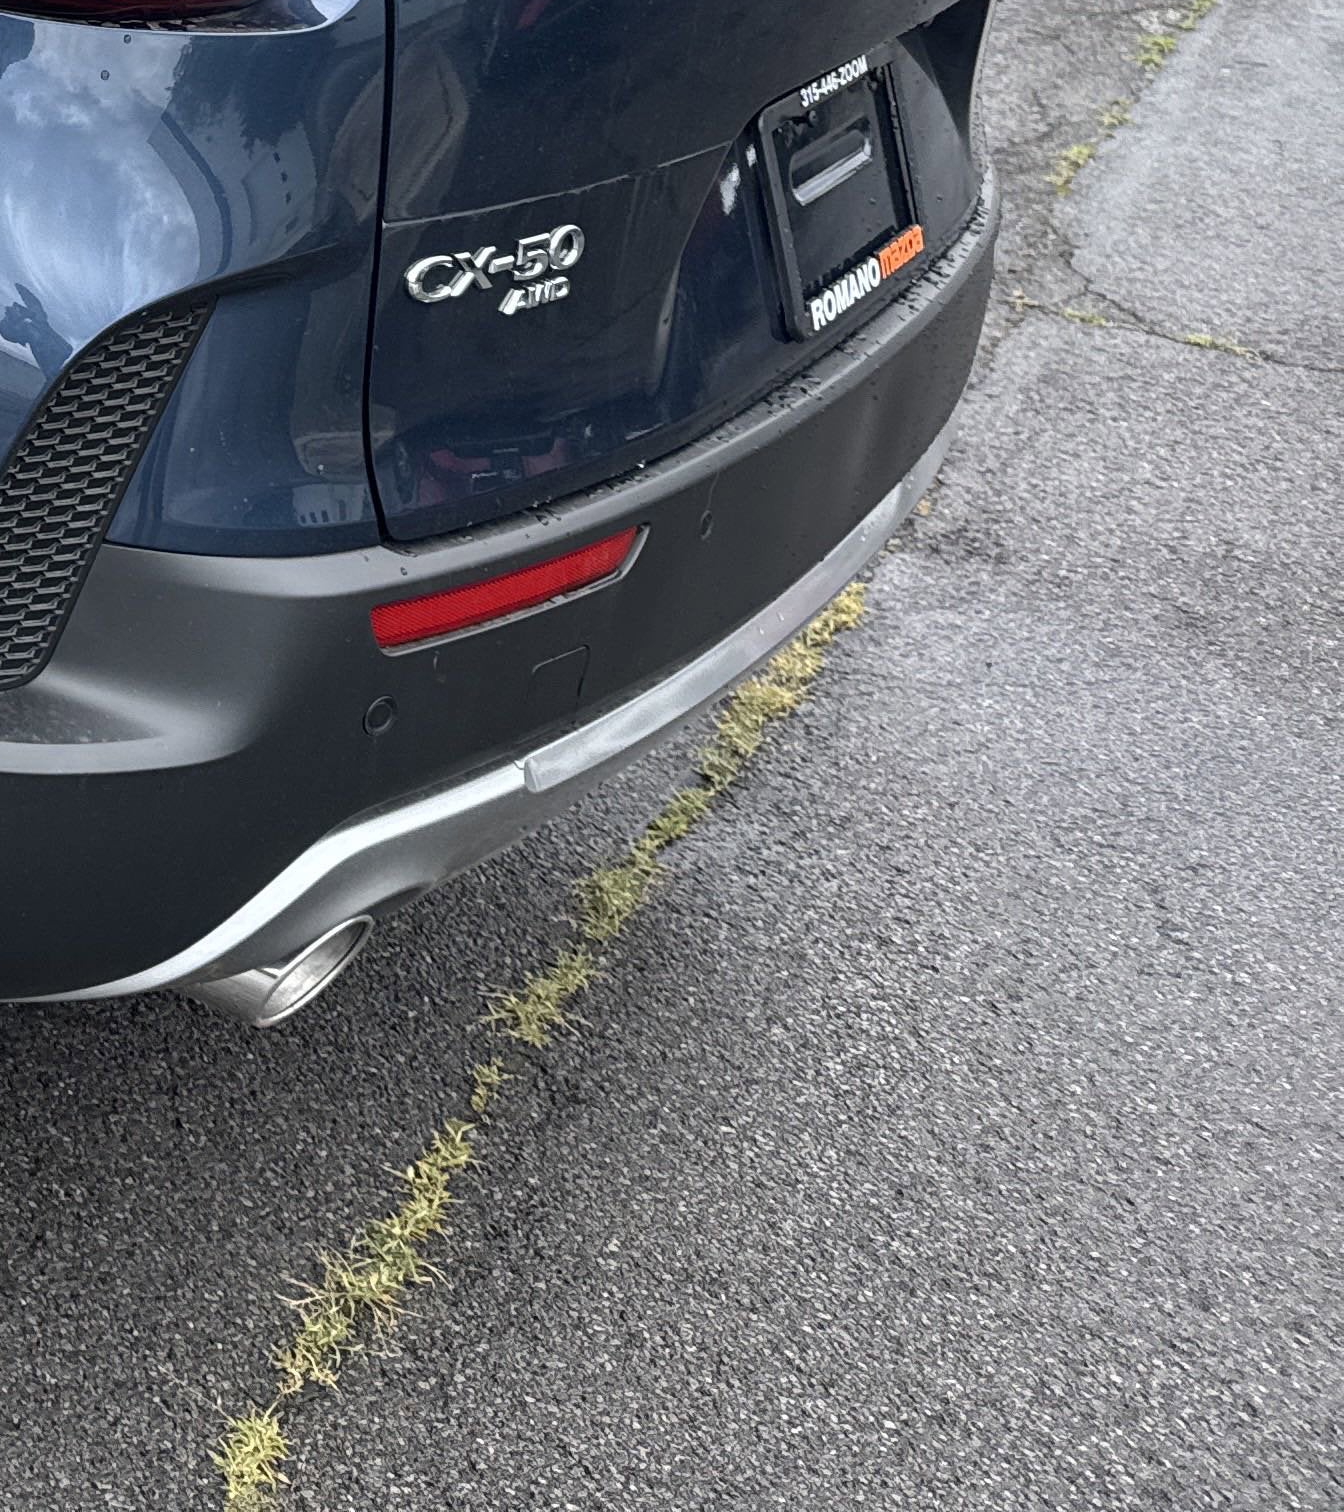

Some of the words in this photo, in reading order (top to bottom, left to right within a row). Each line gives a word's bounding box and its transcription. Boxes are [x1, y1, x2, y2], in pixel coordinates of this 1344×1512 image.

[800, 54, 868, 107] 315-446-ZOOM
[404, 224, 585, 303] CX-50
[498, 276, 570, 315] AWD
[810, 256, 881, 331] ROMANO
